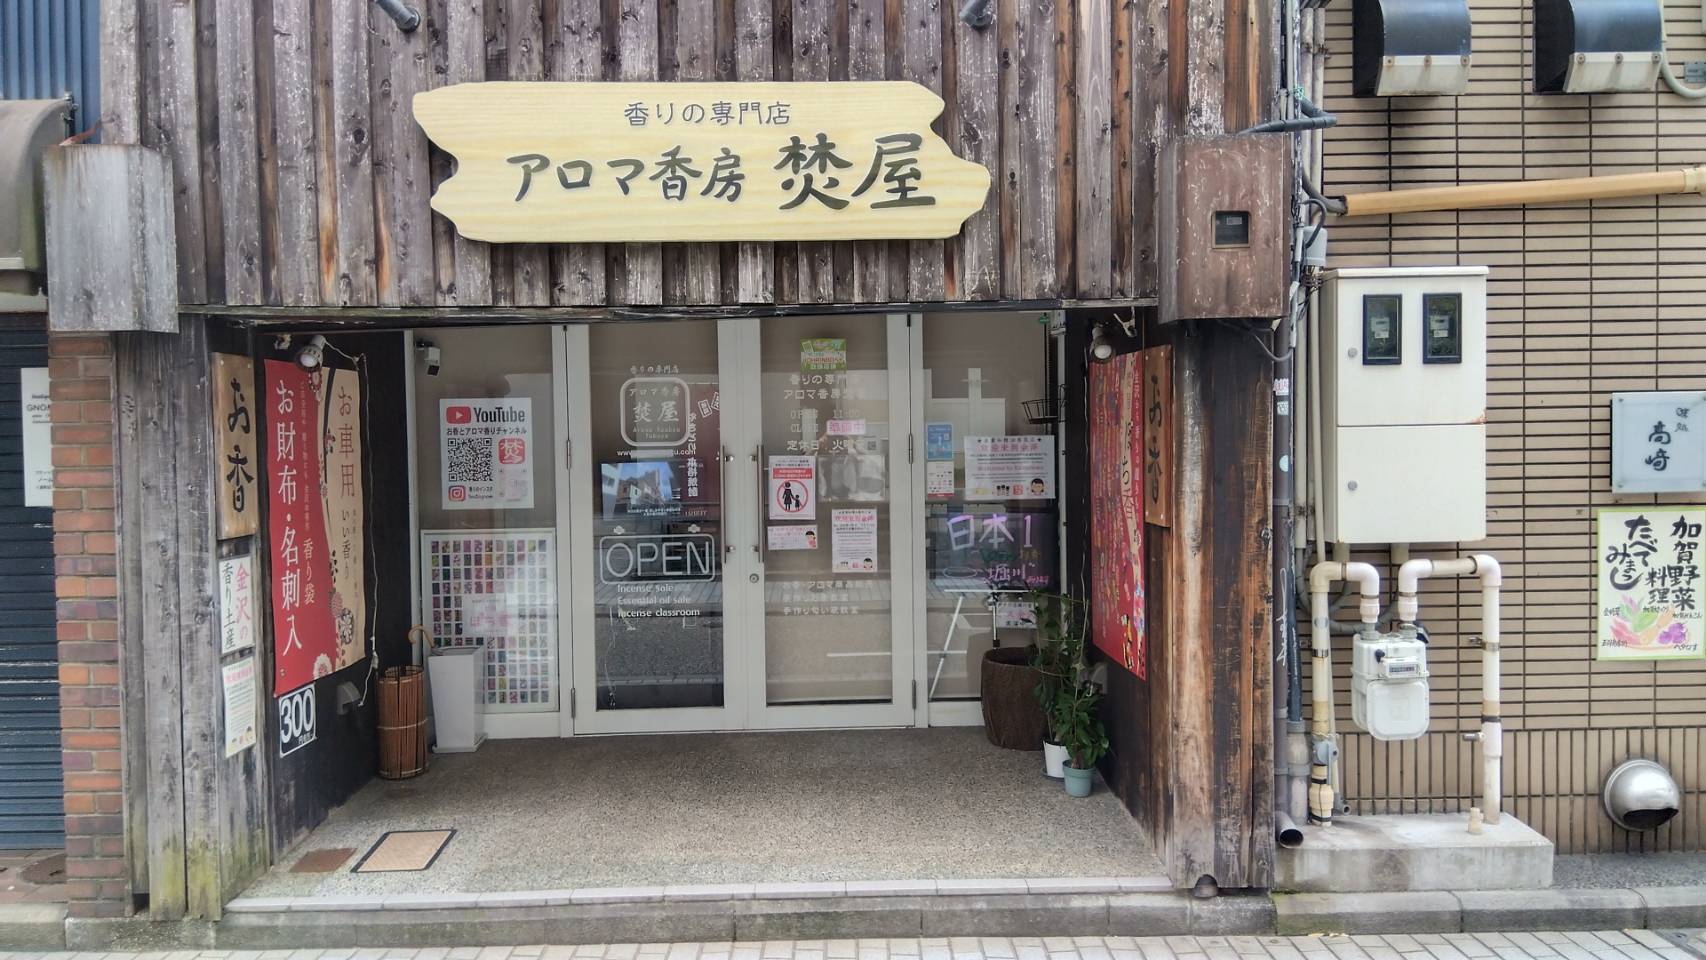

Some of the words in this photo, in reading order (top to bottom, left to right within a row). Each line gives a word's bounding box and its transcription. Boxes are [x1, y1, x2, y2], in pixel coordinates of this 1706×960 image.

[623, 101, 791, 127] 香りの専門店
[505, 145, 746, 202] アロマ香房
[773, 132, 937, 211] 焚屋
[790, 374, 858, 385] 香りの専門
[473, 406, 525, 423] YouTube
[633, 400, 680, 423] 焚屋
[227, 377, 255, 513] お香
[338, 386, 355, 498] お車用
[606, 541, 710, 578] OPEN
[1624, 514, 1658, 567] たべて
[1667, 514, 1703, 612] 加賀野菜
[235, 562, 251, 641] 金沢の
[1645, 567, 1669, 606] 料理
[655, 608, 700, 617] classroom
[280, 688, 315, 744] 300
